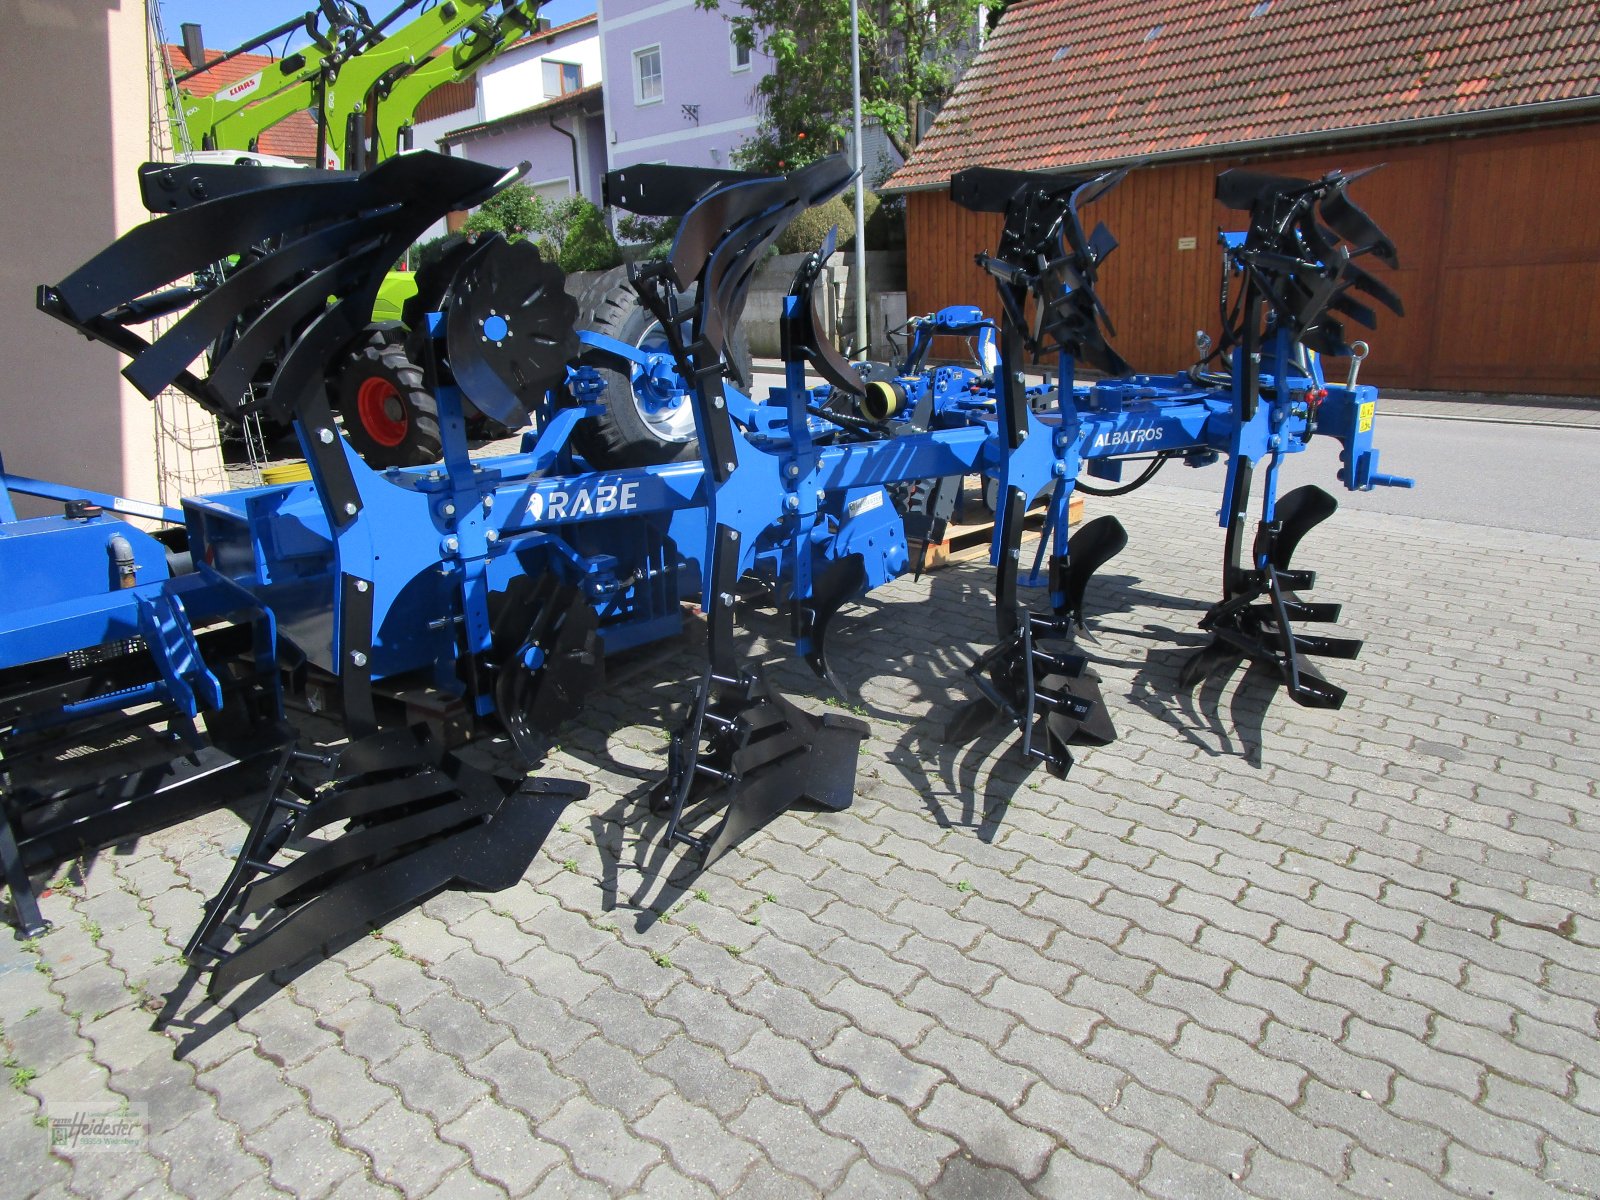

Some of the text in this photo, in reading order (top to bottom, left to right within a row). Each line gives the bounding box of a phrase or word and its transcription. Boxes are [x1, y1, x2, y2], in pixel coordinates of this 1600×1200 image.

[229, 79, 255, 96] CLAAS
[1094, 427, 1163, 447] ALBATROS
[548, 482, 640, 519] RABE
